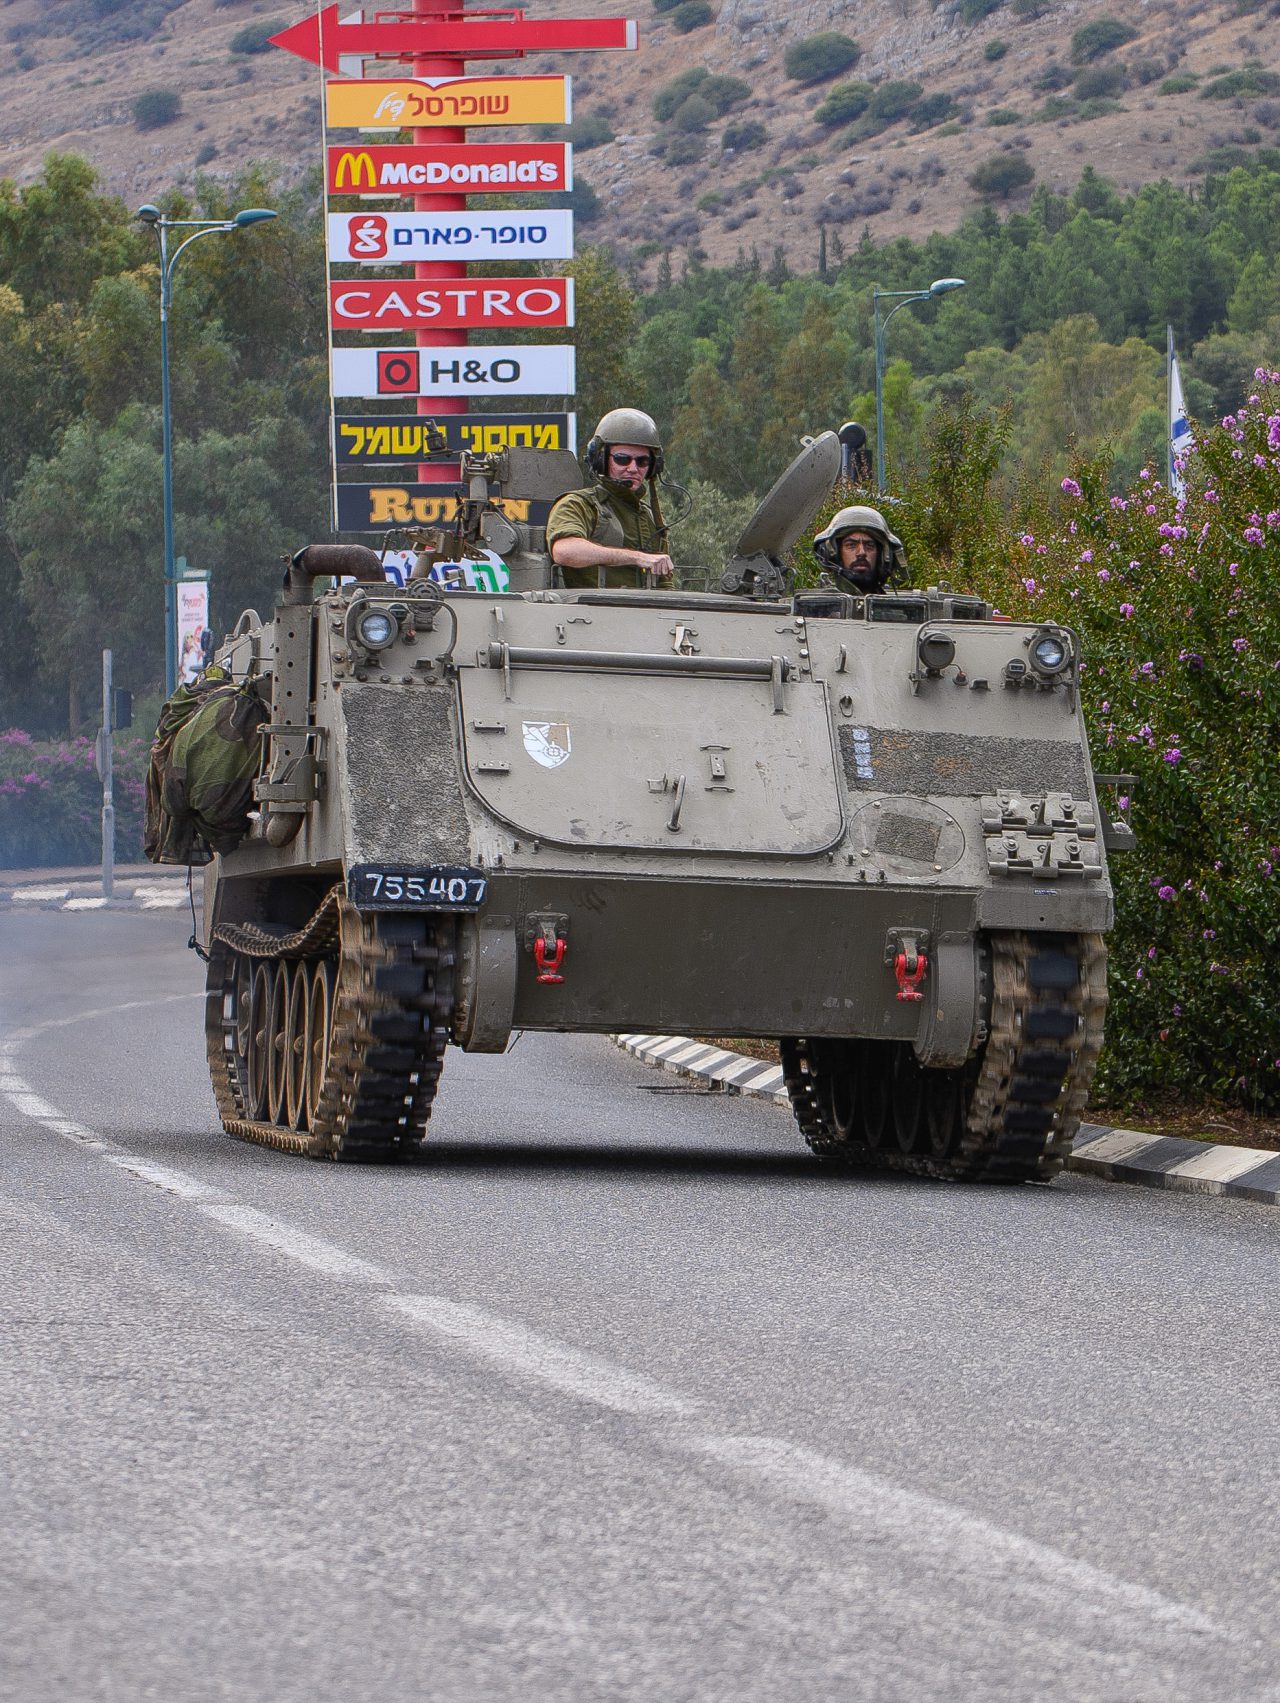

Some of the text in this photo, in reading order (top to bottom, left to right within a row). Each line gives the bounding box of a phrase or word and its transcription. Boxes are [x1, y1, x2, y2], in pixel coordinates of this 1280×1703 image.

[406, 93, 510, 117] שופרסל
[380, 160, 558, 185] McDonald's
[334, 288, 562, 319] CASTRO
[430, 359, 521, 383] H&O
[460, 424, 560, 454] מחסני
[368, 488, 532, 524] RUN
[365, 873, 487, 902] 755407
